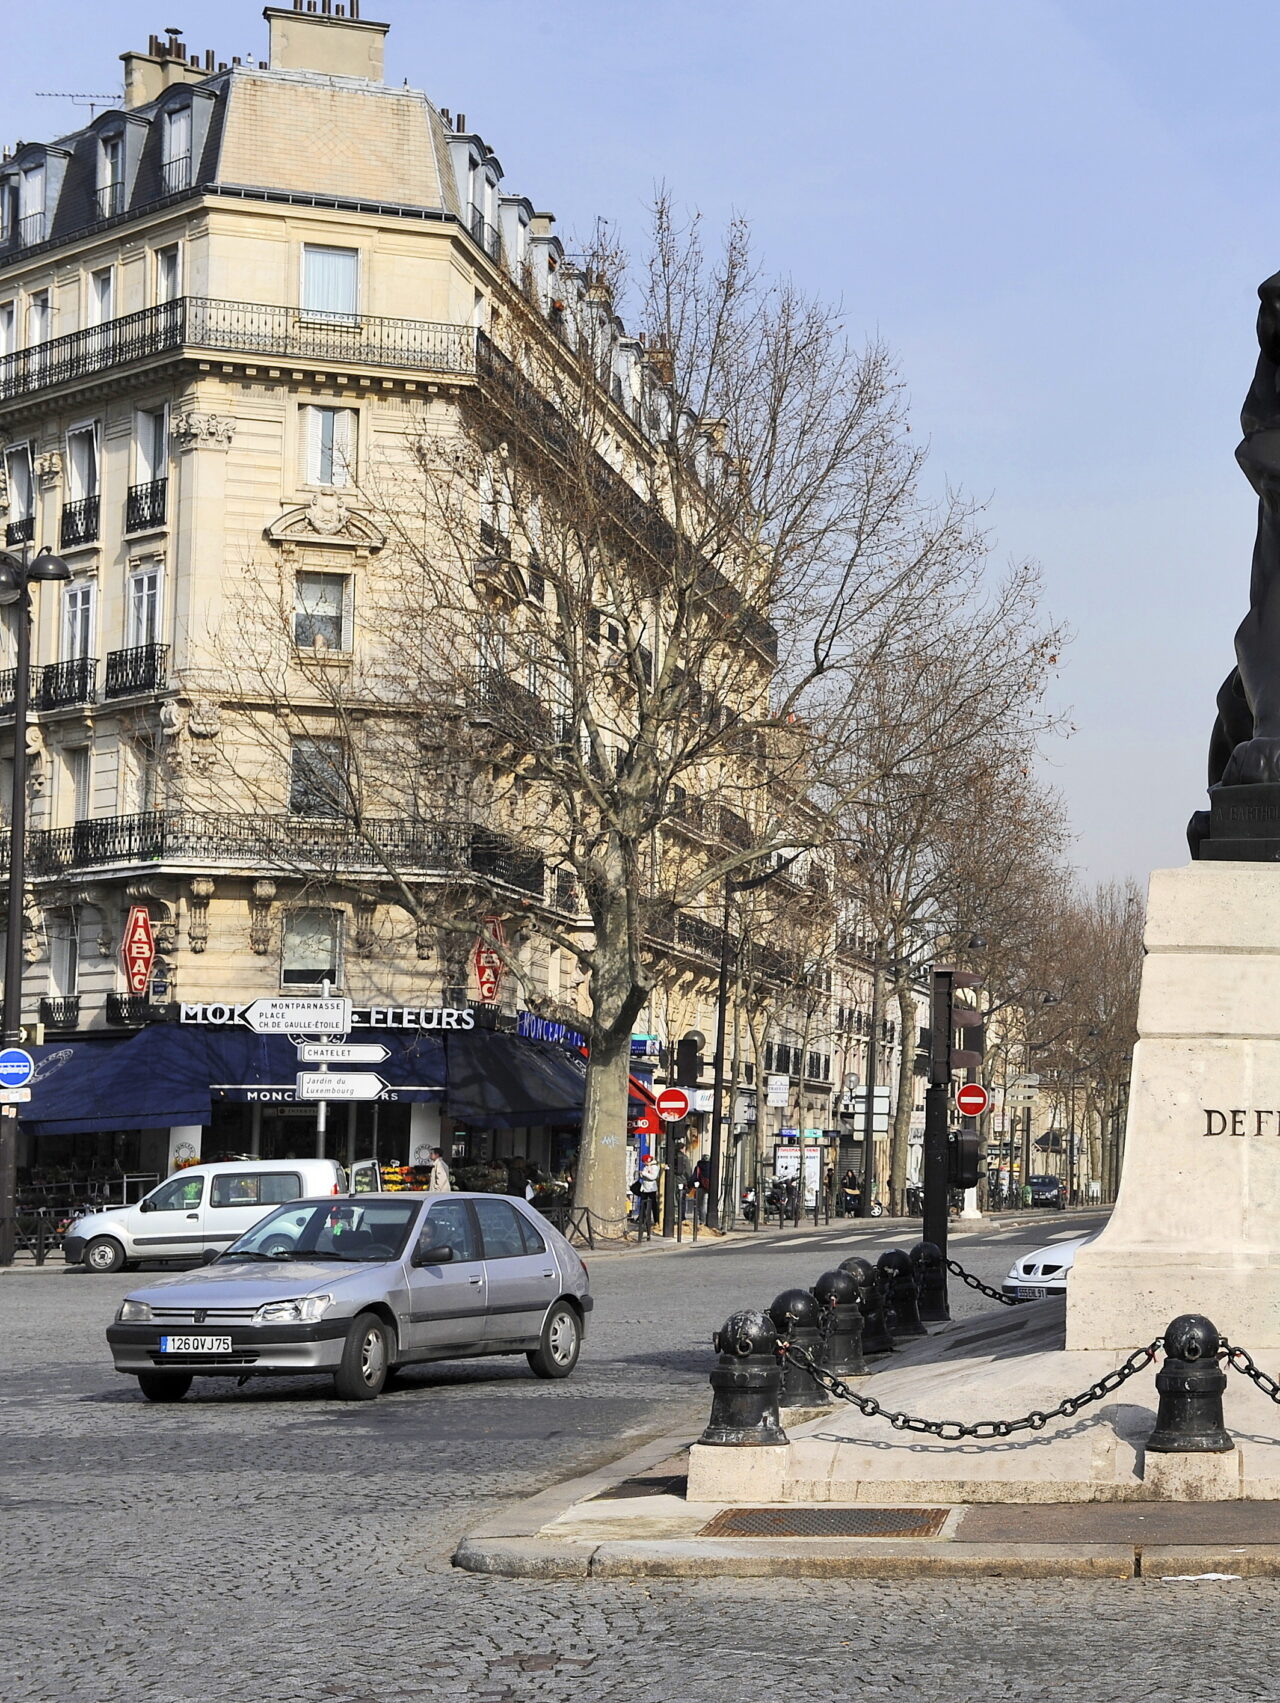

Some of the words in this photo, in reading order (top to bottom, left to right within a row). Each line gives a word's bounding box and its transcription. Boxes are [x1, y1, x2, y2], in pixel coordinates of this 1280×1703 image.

[131, 911, 151, 990] TABAC
[271, 1002, 341, 1010] MONTPARNASSE
[370, 1006, 475, 1030] FLEURS
[272, 1021, 282, 1029] DE
[307, 1049, 351, 1057] CHATELET
[306, 1077, 332, 1085] Jardin
[336, 1077, 346, 1085] du
[306, 1087, 355, 1096] Luxembourg
